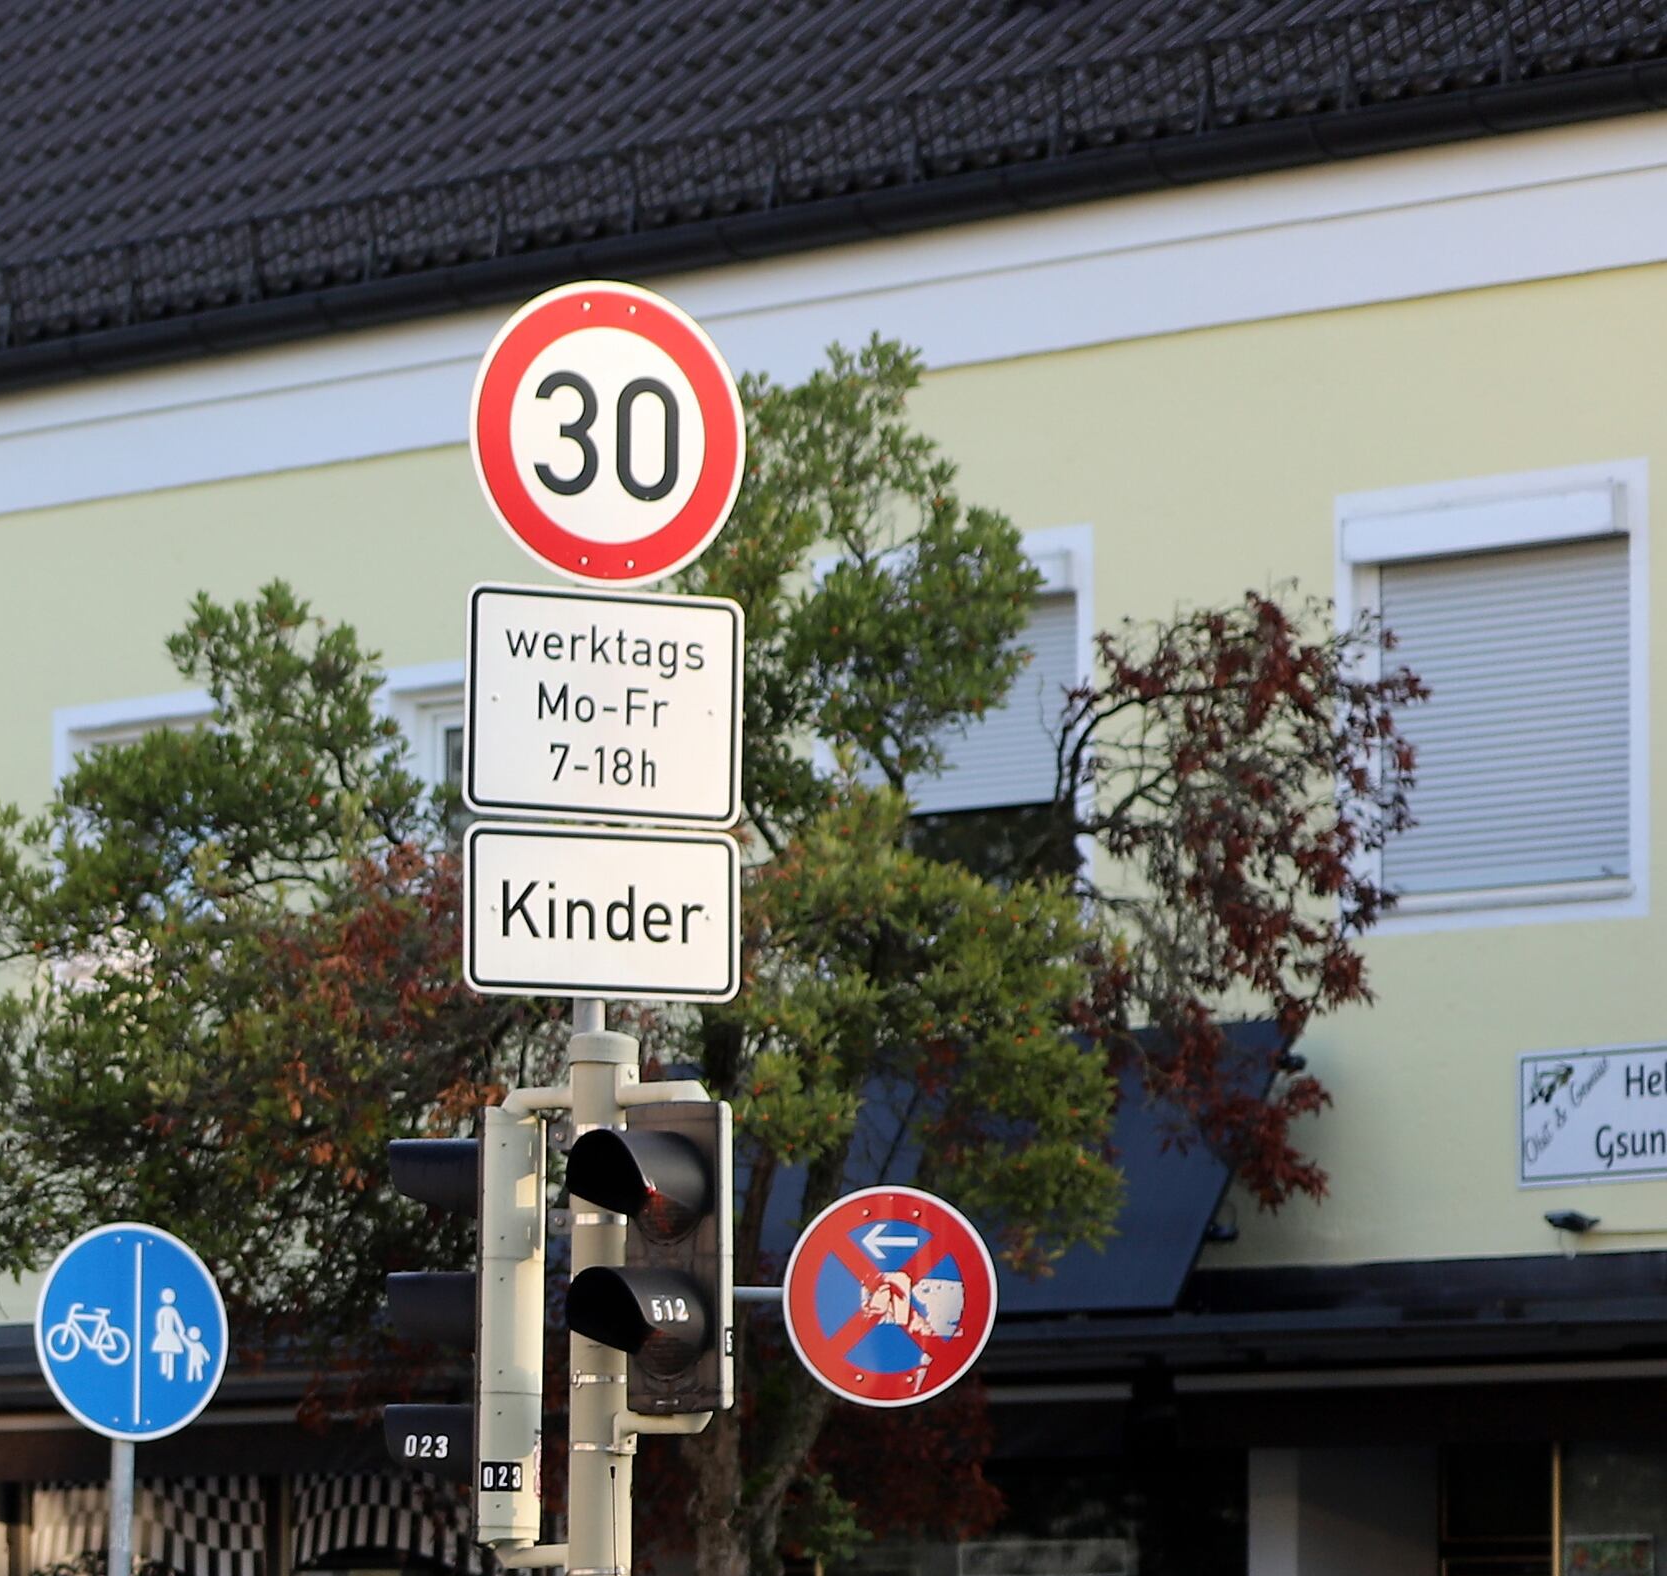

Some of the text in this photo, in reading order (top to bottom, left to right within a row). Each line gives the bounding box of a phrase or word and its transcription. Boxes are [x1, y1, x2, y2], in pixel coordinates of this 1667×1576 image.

[533, 370, 679, 501] 30
[506, 628, 706, 680] werktags
[536, 682, 669, 729] Mo-Fr
[548, 743, 658, 788] 7-18h
[499, 880, 703, 944] Kinder
[651, 1298, 689, 1321] 512
[404, 1435, 448, 1459] 023
[483, 1466, 521, 1488] 023
